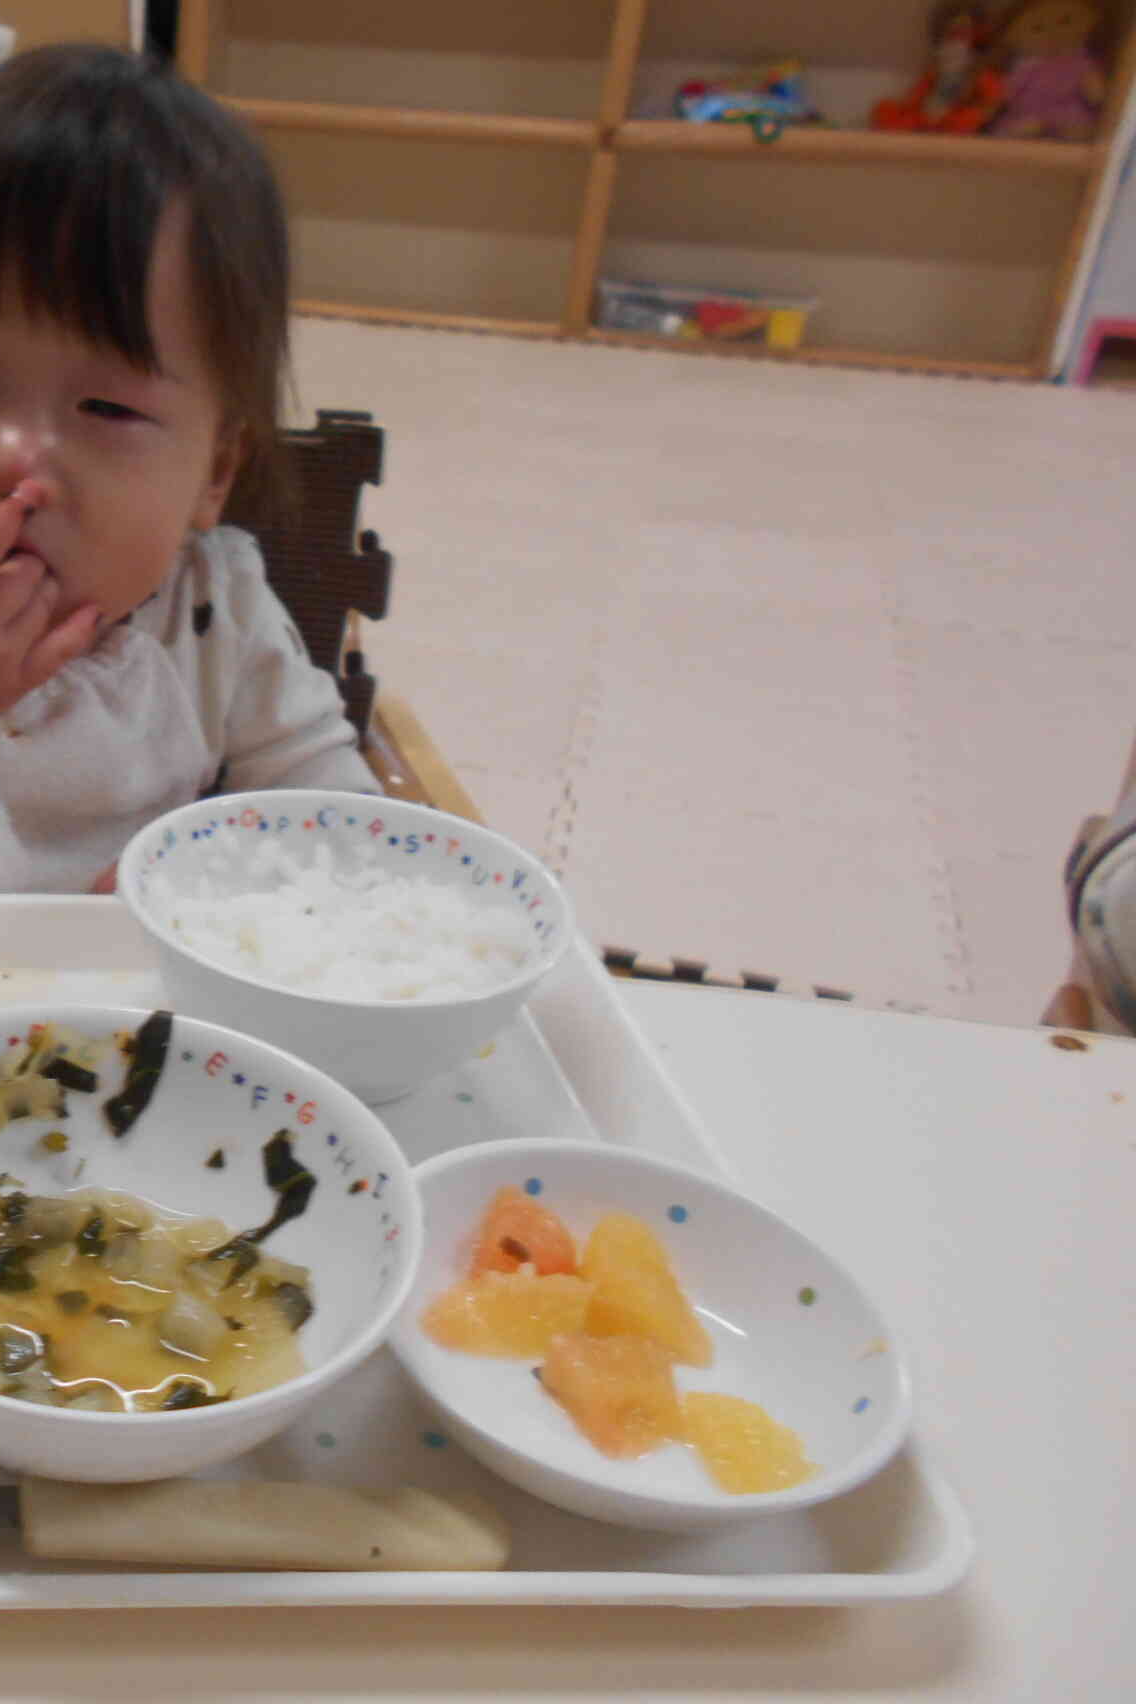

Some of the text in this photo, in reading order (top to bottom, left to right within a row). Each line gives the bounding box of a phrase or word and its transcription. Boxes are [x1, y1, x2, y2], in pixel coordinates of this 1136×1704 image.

[404, 833, 421, 855] S
[204, 1051, 228, 1078] E
[250, 1085, 270, 1110] F
